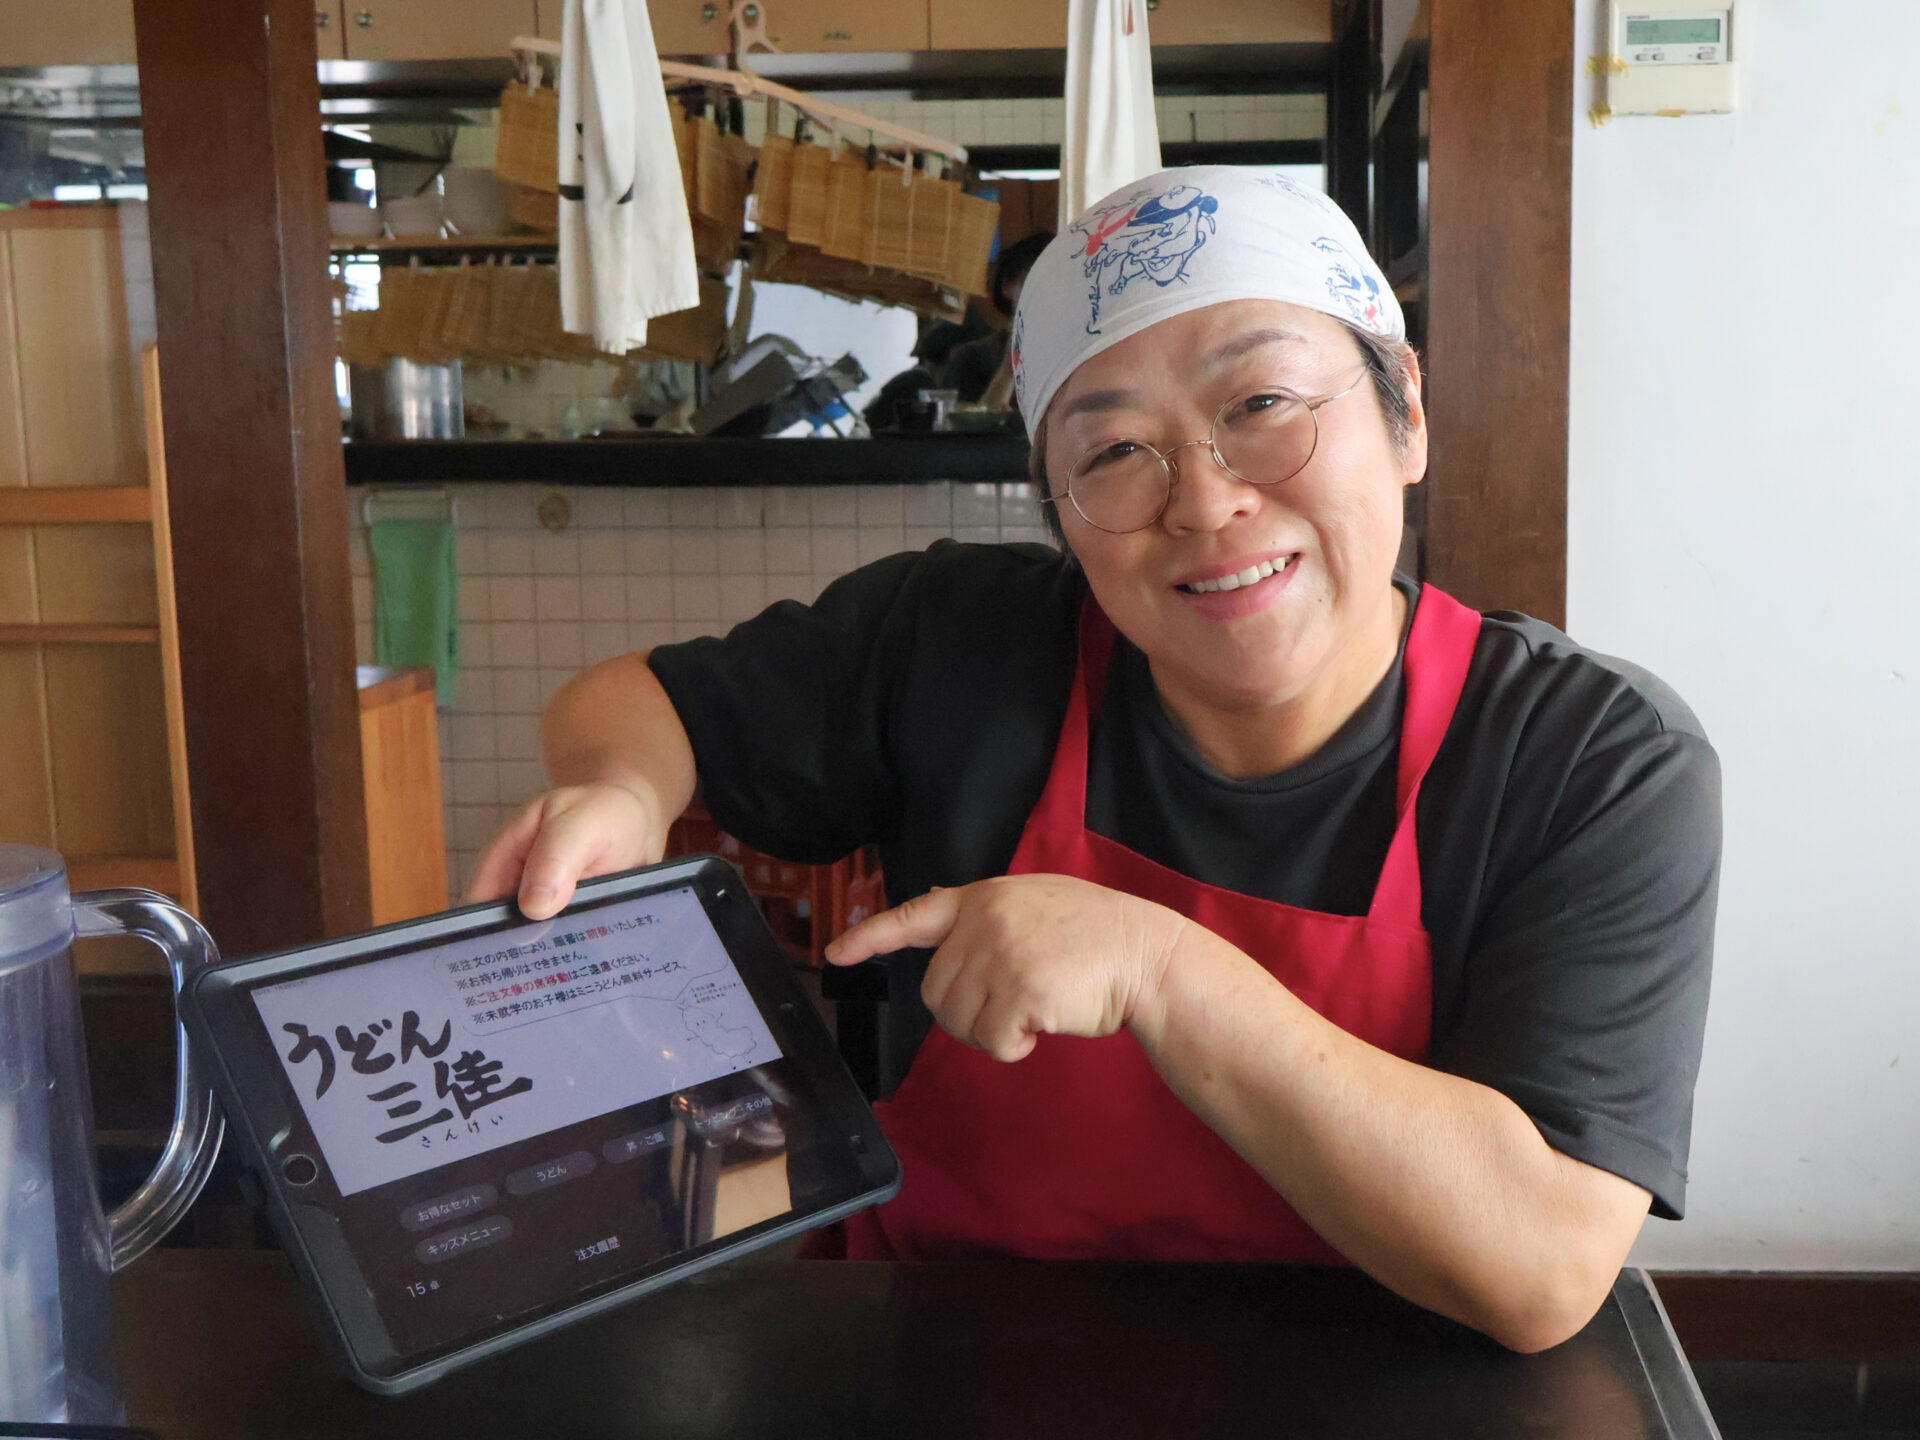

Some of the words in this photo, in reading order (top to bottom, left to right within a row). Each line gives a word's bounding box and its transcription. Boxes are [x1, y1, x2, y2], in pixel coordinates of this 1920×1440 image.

[456, 951, 588, 990] ※お持ち帰りはできません。
[282, 1010, 451, 1100] うどん
[367, 1050, 533, 1143] 三佳
[420, 1115, 504, 1149] さんけい
[536, 1166, 567, 1182] うどん
[417, 1193, 481, 1223] お得なセット
[426, 1225, 501, 1257] キッズメニュー
[406, 1281, 426, 1298] 15
